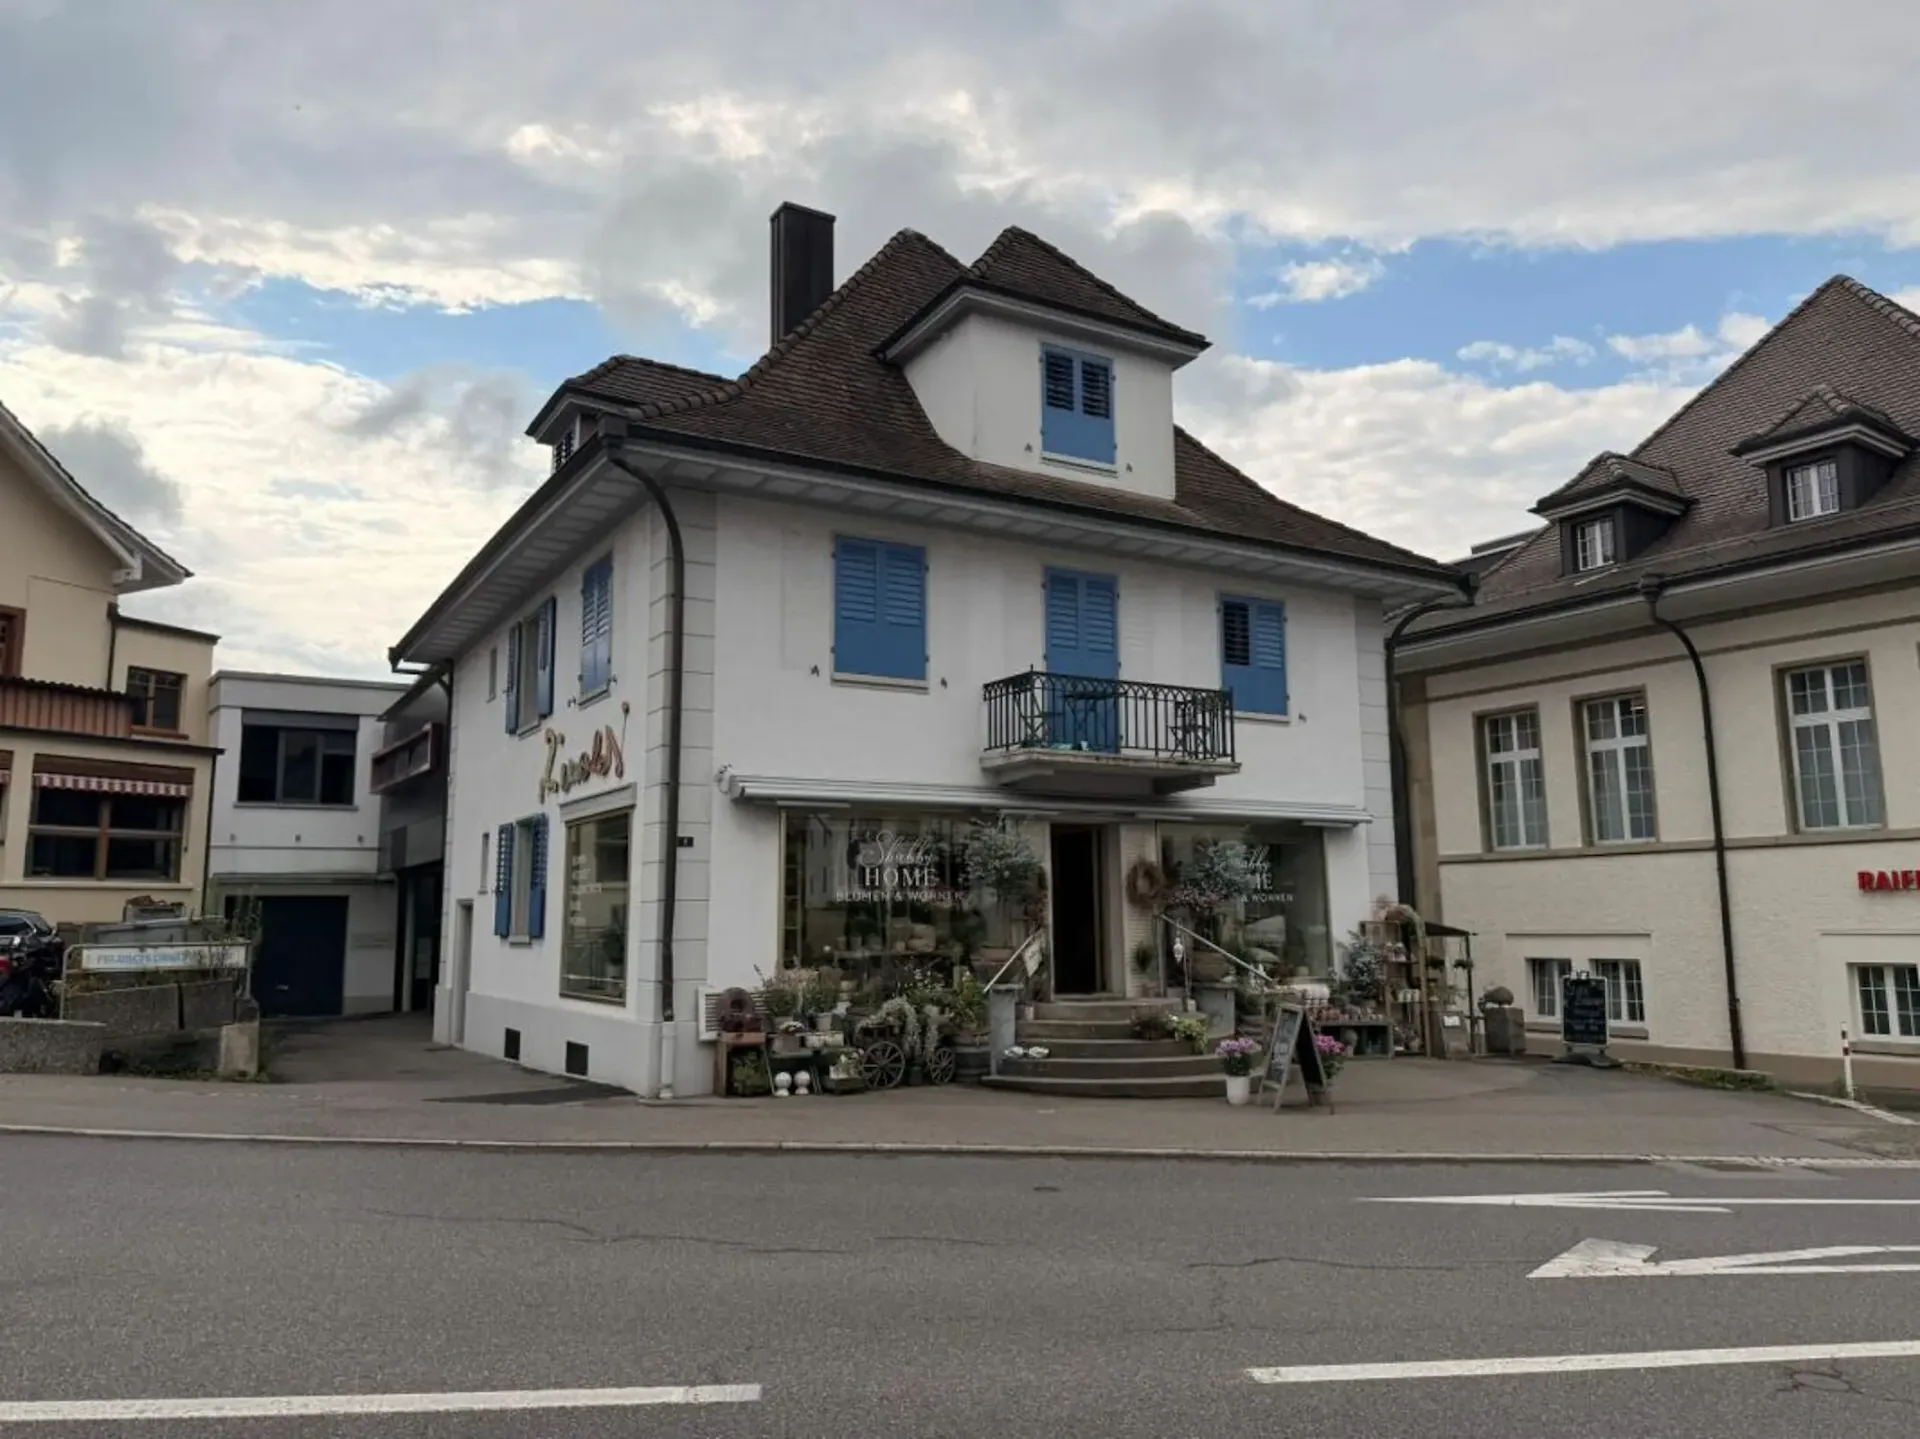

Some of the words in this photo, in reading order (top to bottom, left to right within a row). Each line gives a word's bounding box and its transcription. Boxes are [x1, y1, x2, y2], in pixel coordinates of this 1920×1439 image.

[857, 830, 932, 866] Shabby
[865, 867, 935, 886] HOME
[836, 890, 889, 903] BLUMEN
[894, 890, 903, 903] &
